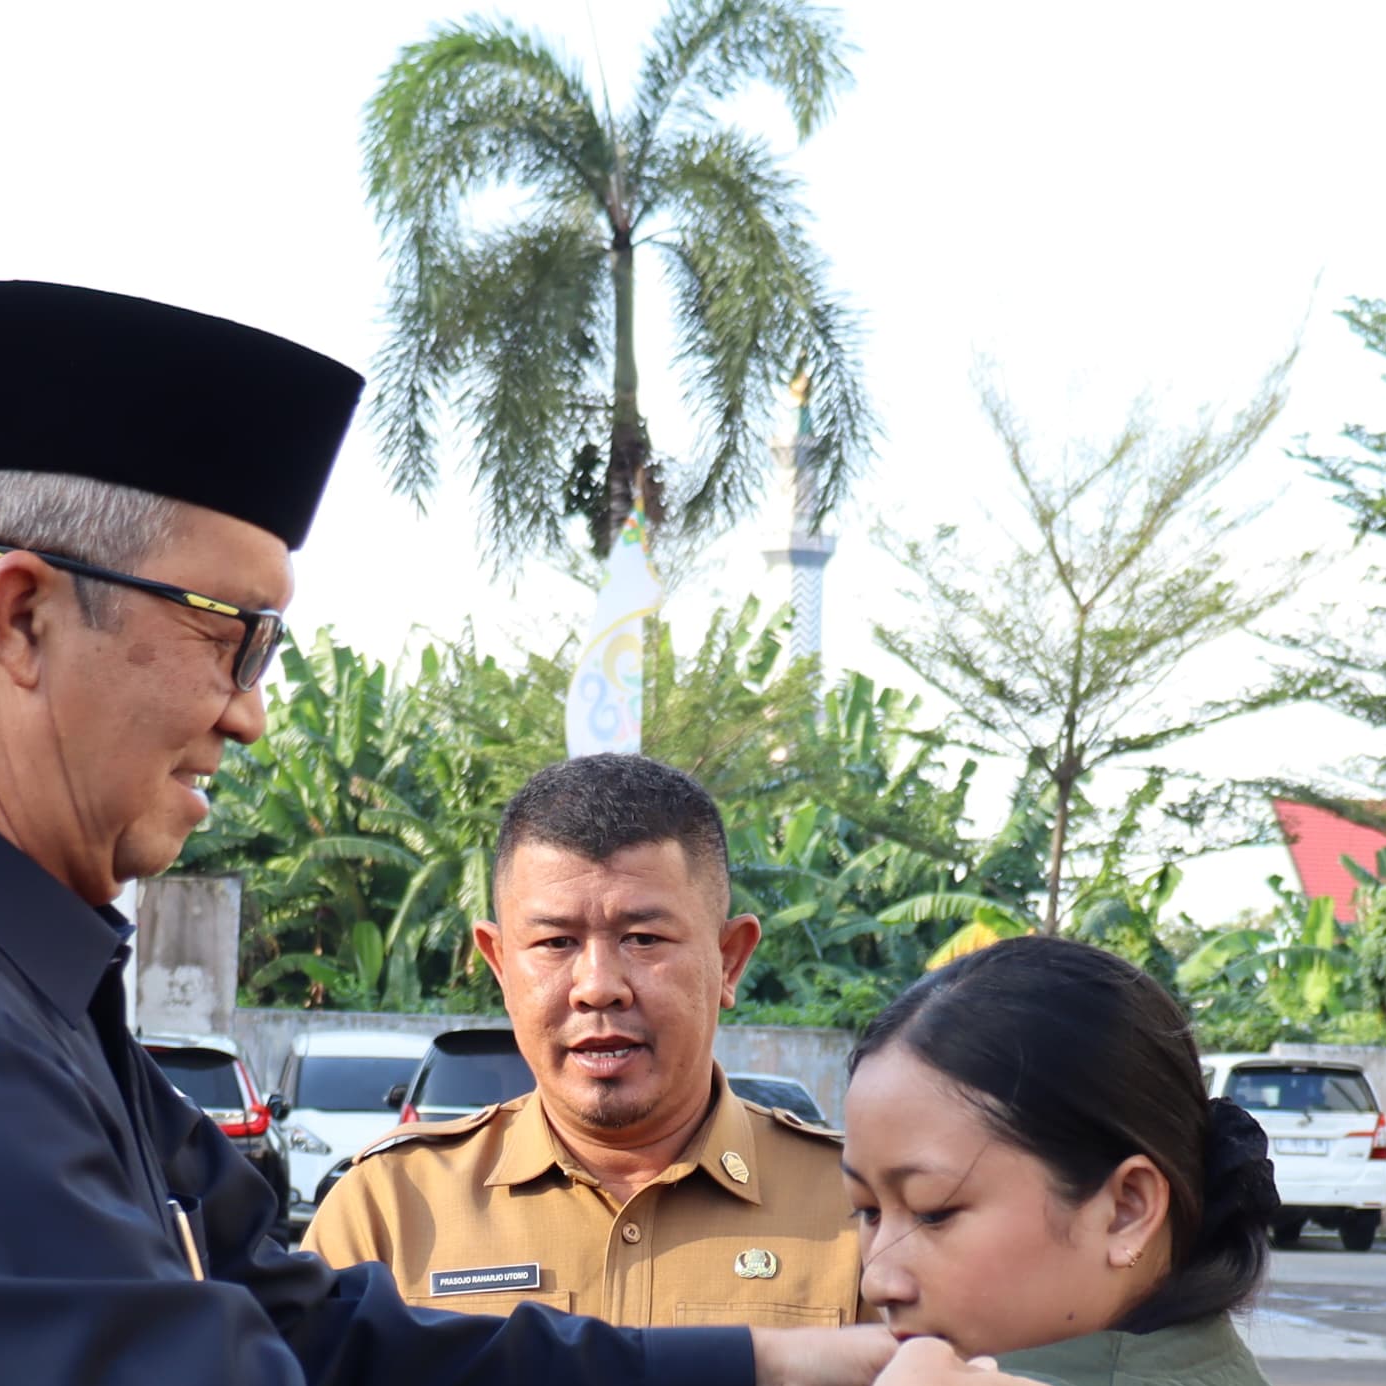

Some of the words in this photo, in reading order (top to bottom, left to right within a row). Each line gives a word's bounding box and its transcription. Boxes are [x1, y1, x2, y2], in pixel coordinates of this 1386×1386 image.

[440, 1278, 471, 1286] PRASOJO
[472, 1275, 503, 1283] RAHARJO
[504, 1272, 528, 1281] UTOMO
